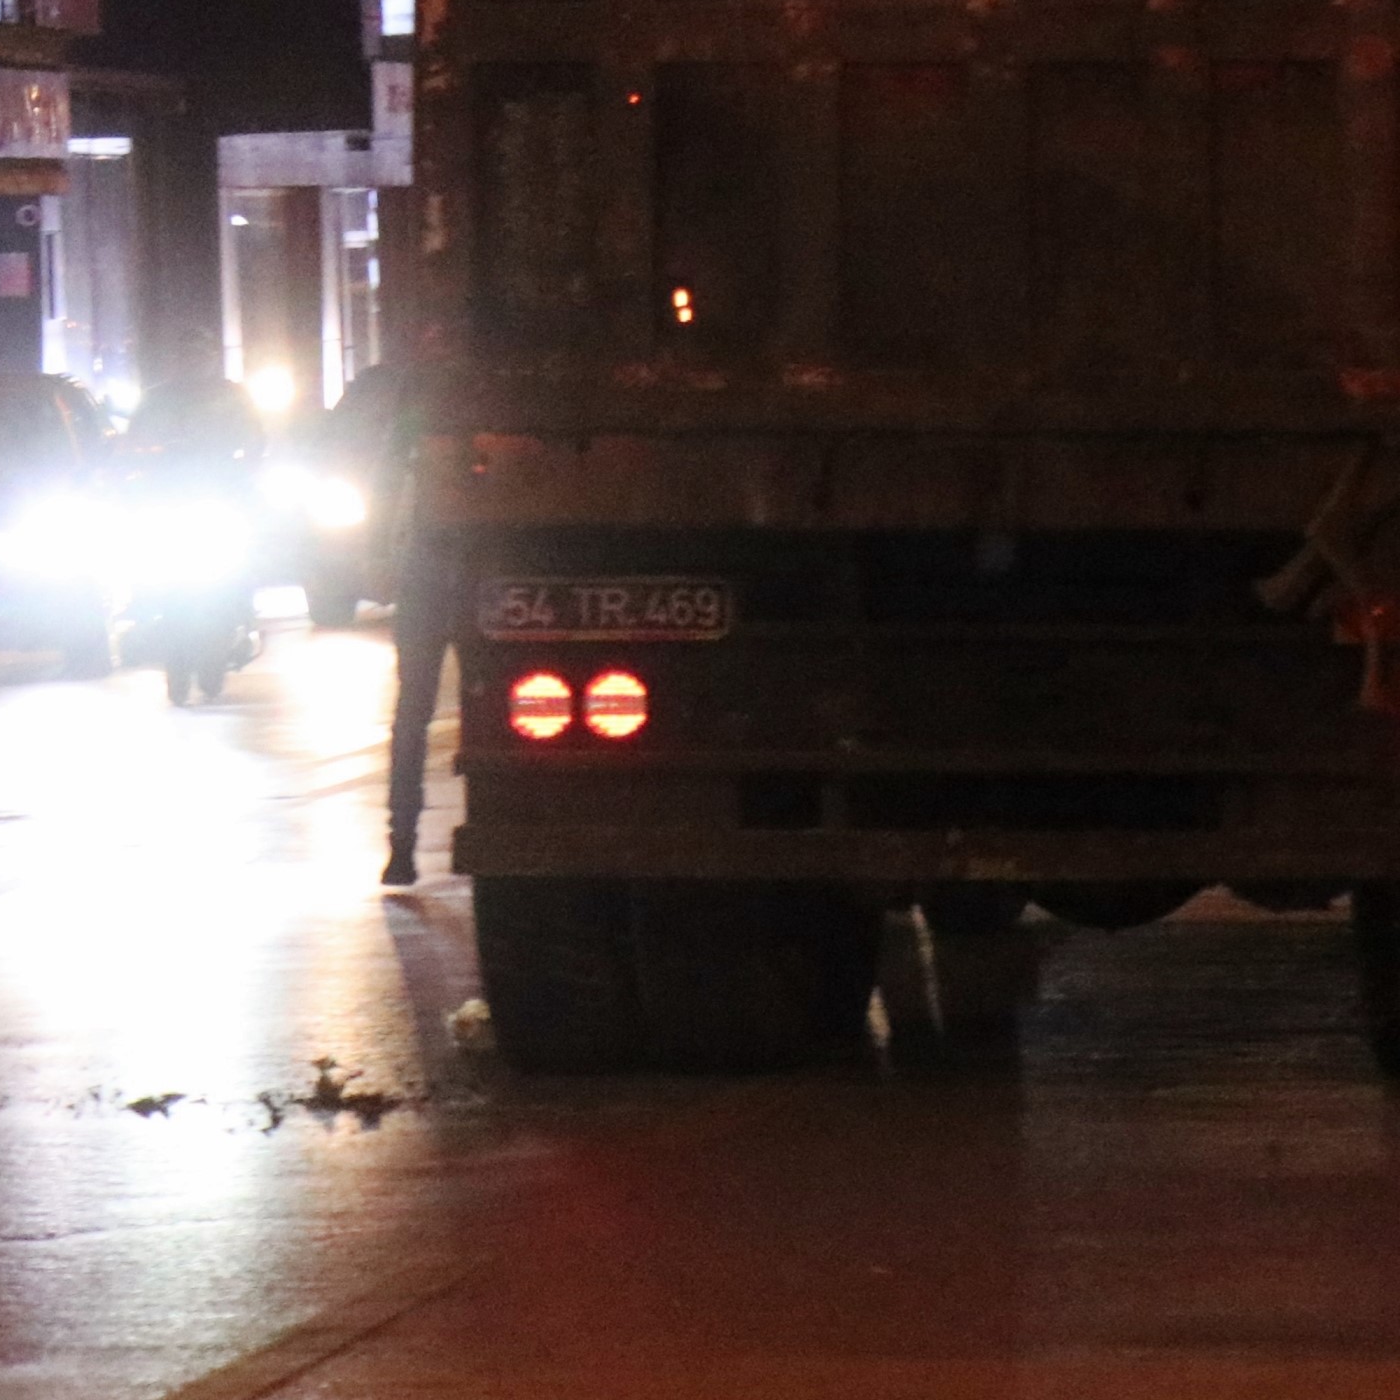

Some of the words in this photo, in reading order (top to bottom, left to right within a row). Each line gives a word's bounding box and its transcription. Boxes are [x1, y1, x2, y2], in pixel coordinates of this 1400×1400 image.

[504, 586, 555, 627] 54
[575, 586, 630, 627] TR
[643, 586, 721, 627] 469
